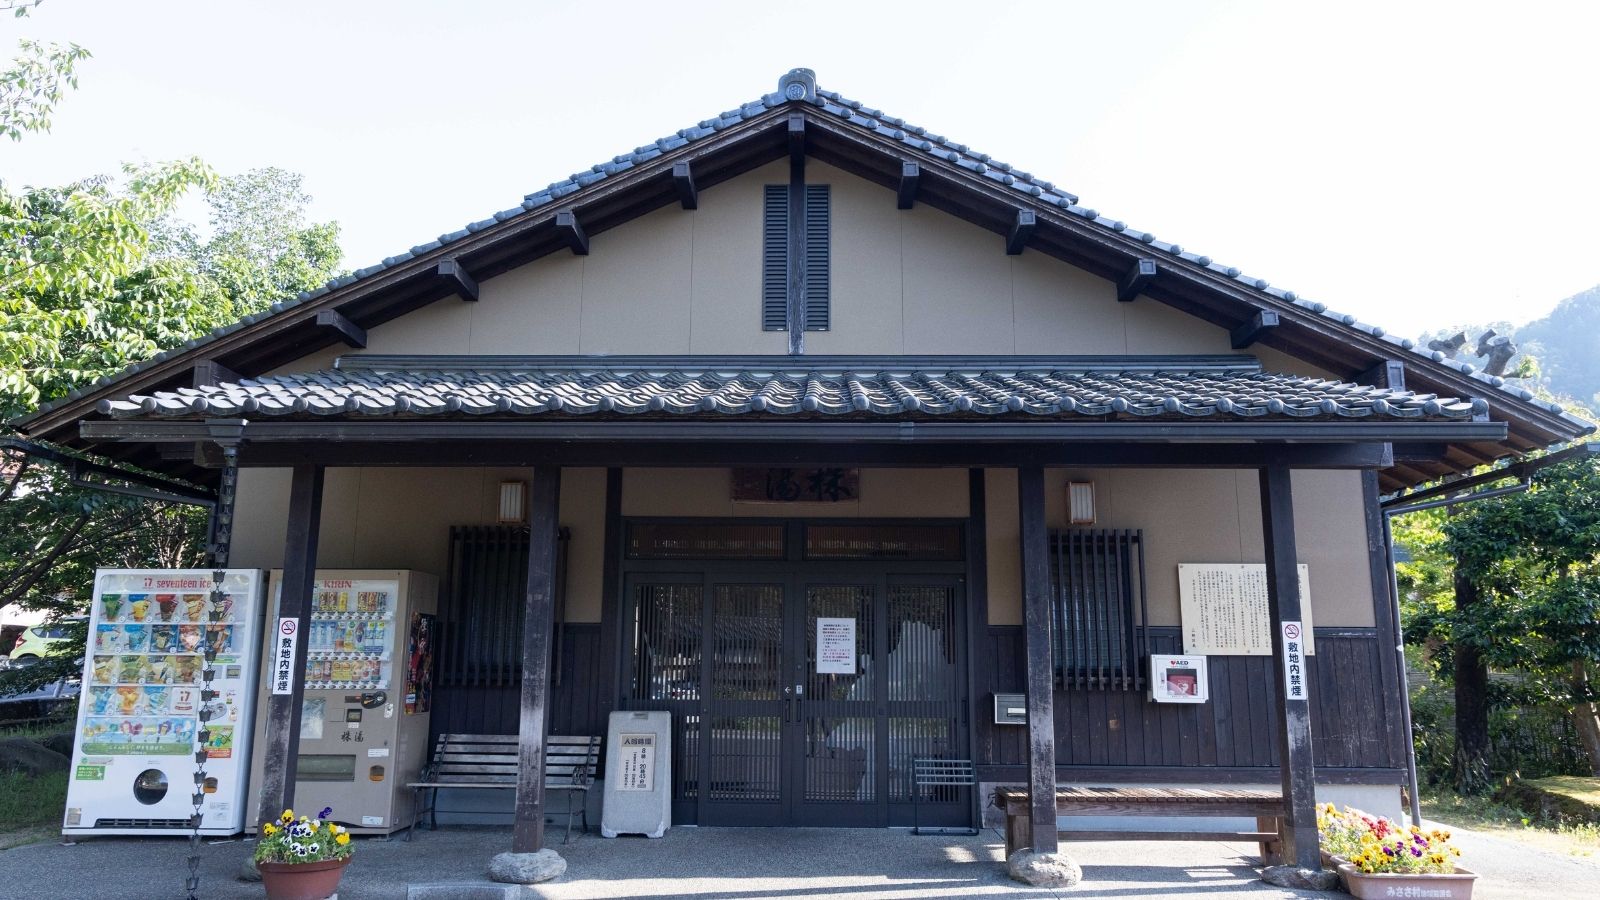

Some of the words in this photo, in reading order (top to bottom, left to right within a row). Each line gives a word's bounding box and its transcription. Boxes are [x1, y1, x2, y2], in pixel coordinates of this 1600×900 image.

[157, 578, 197, 588] seventeen
[200, 577, 212, 588] ice
[324, 580, 352, 588] KIRIN
[278, 638, 292, 691] 敷地内禁煙
[1287, 642, 1302, 696] 敷地内禁煙
